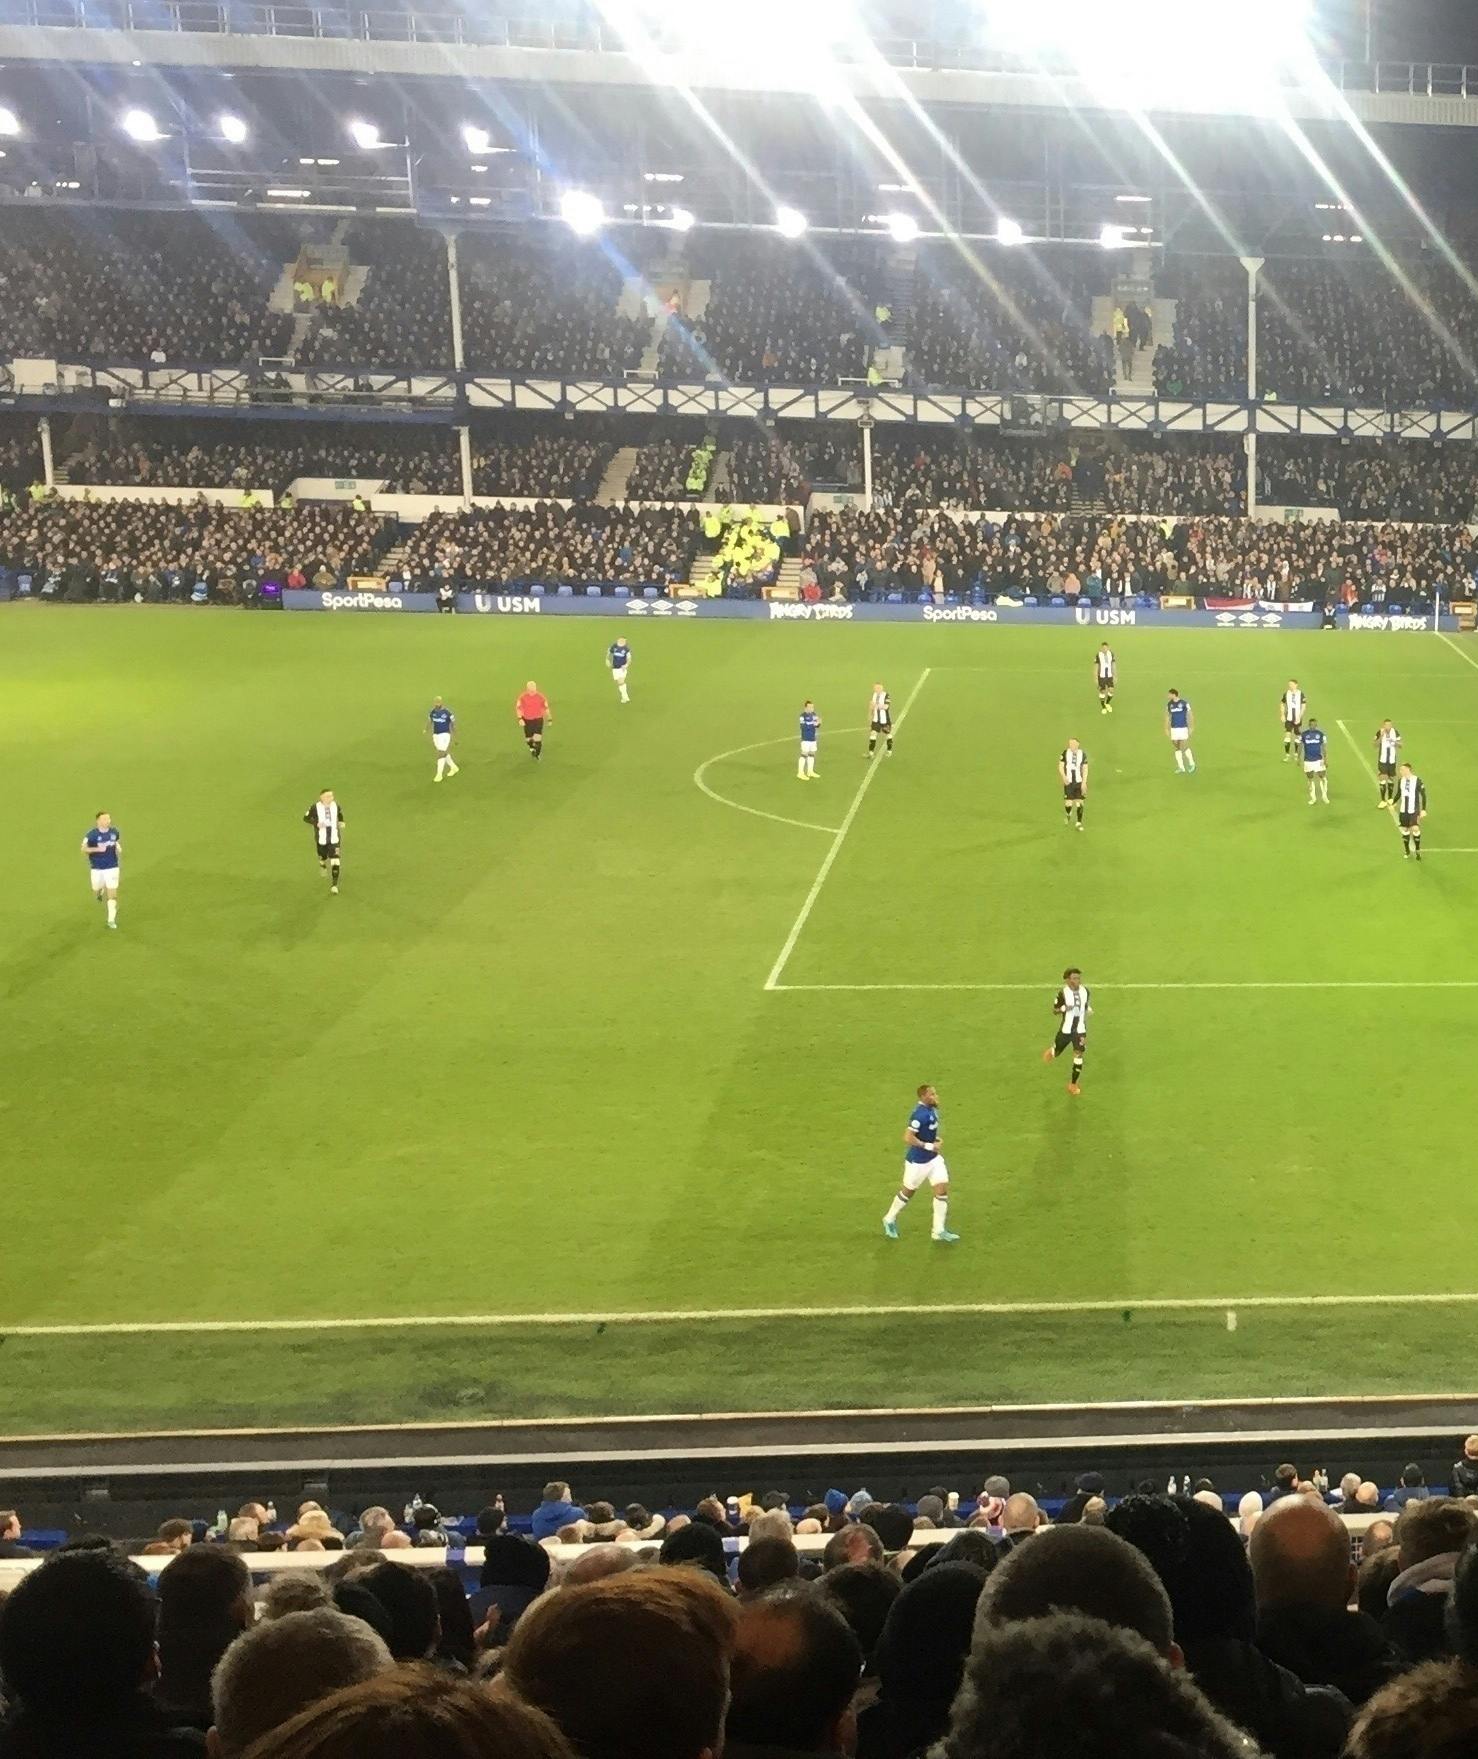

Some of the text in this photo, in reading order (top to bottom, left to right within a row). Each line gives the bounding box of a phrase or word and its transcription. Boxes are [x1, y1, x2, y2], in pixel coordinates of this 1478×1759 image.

[322, 592, 403, 610] SportPesa
[498, 597, 541, 613] USM
[923, 605, 997, 623] SportPesa
[1096, 610, 1135, 625] USM
